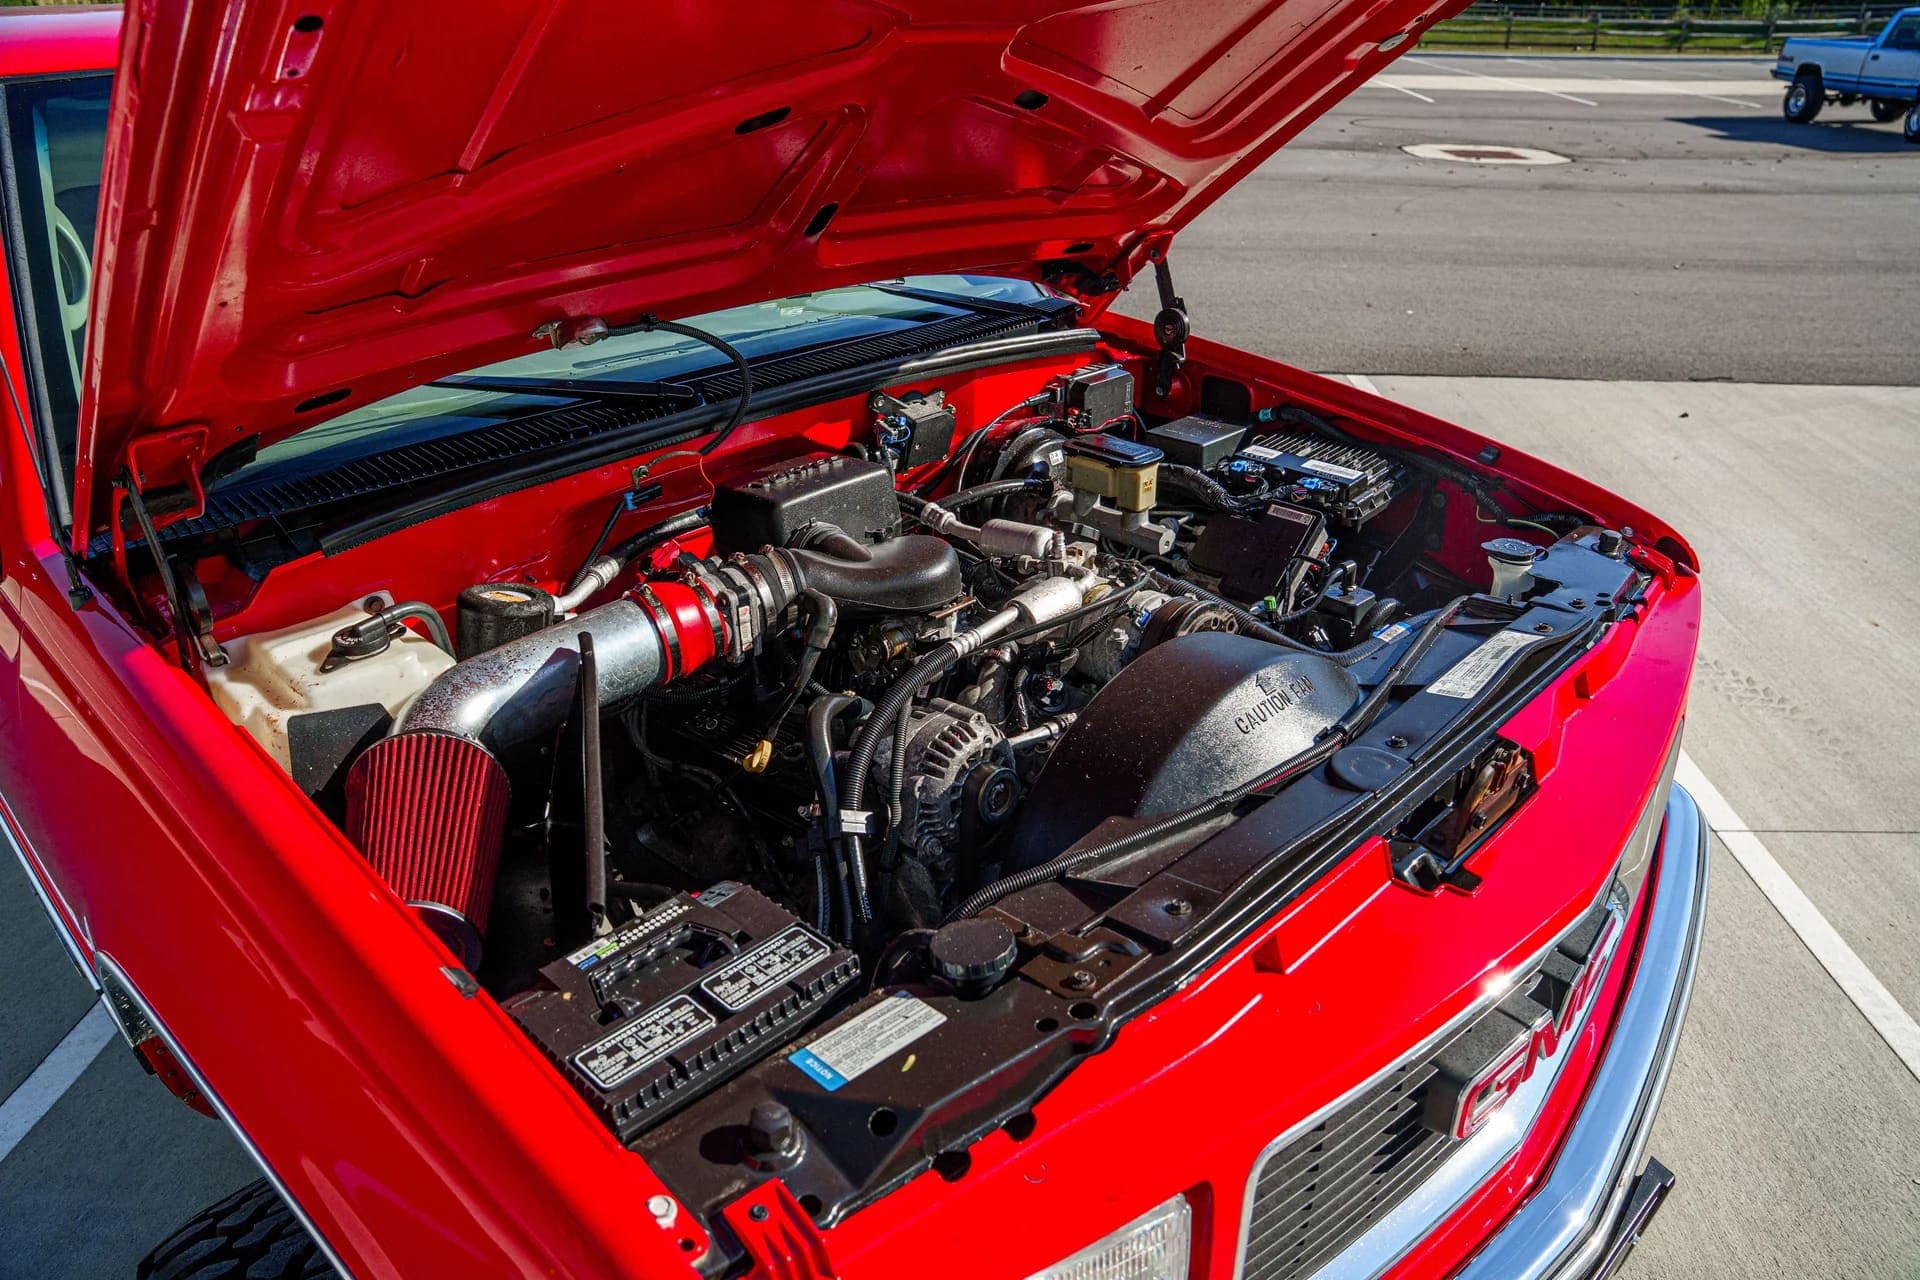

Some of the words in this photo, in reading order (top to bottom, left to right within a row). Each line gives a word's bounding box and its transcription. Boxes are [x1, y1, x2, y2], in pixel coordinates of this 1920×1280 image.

[1234, 690, 1293, 734] CAUTION
[1289, 675, 1316, 699] FAN
[1455, 918, 1616, 1140] GMC
[804, 1057, 834, 1081] NOTICE
